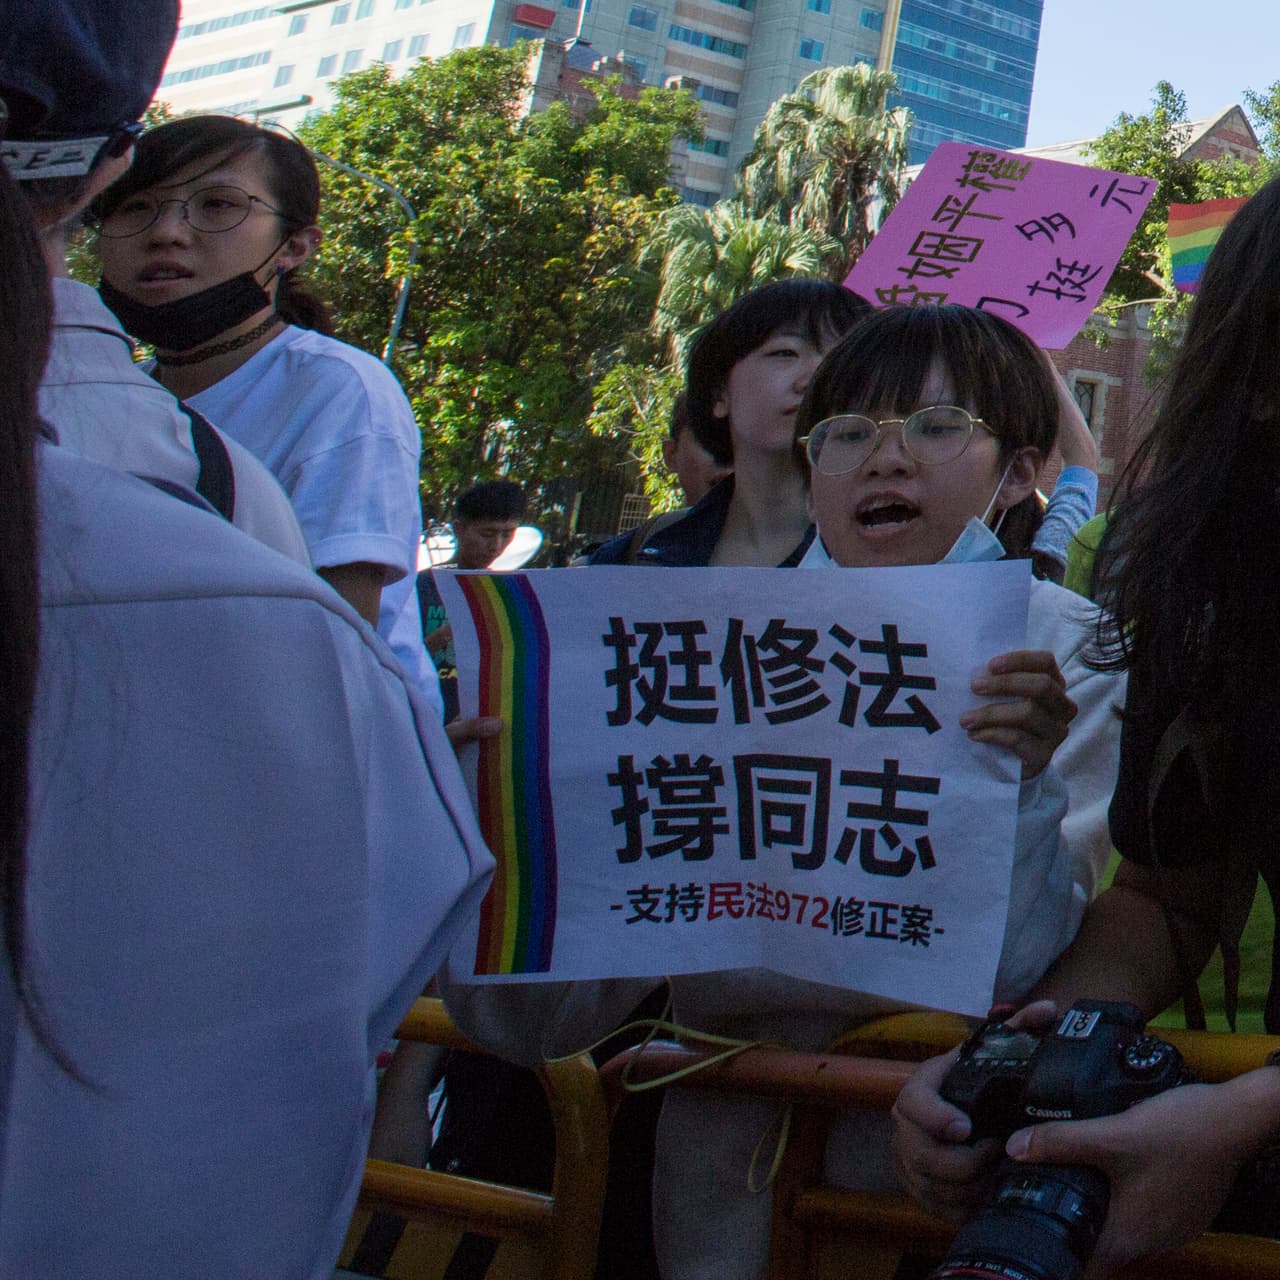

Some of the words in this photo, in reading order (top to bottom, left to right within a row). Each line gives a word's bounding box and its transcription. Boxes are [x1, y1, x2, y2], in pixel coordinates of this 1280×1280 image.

[602, 616, 941, 734] 挺修法
[607, 753, 941, 877] 撐同志
[1026, 1105, 1073, 1119] Canon
